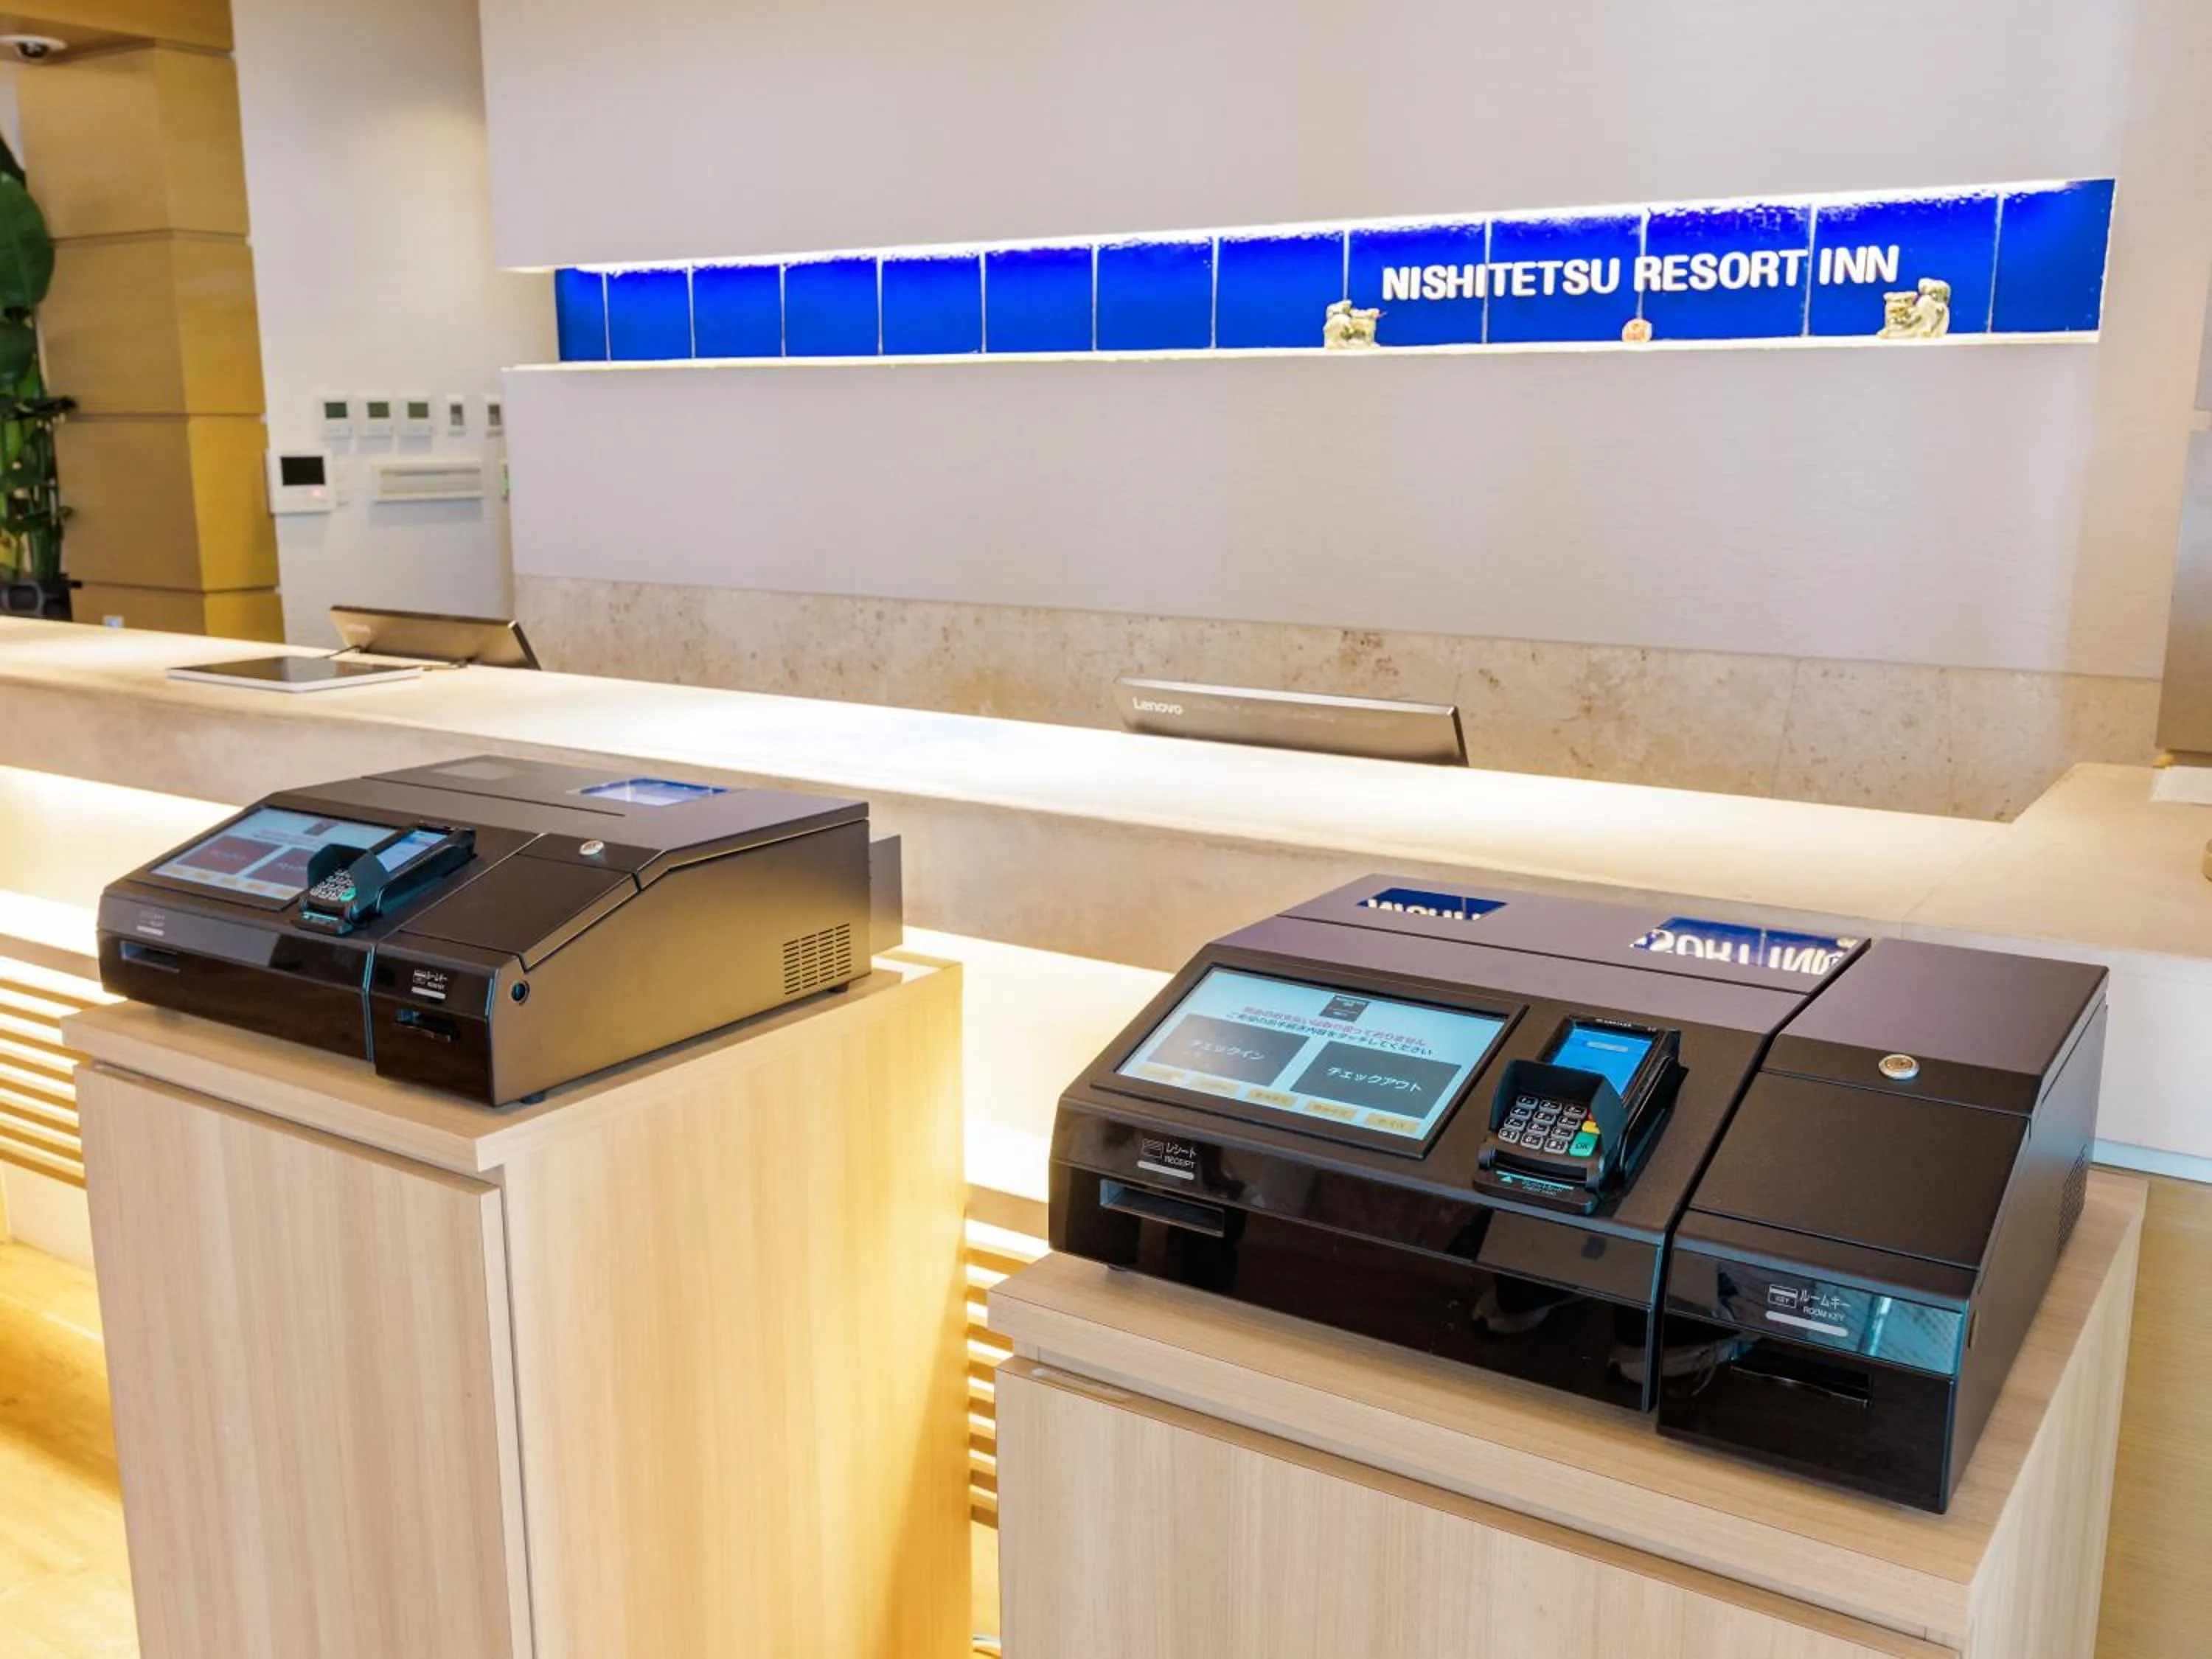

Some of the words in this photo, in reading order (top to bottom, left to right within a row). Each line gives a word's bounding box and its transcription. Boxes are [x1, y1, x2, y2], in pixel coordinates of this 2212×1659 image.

[1382, 259, 1620, 301] NISHITETSU
[1632, 249, 1809, 293] RESORT
[1818, 245, 1900, 285] INN
[1132, 697, 1183, 715] Lenovo
[1189, 1039, 1265, 1061] チェックイン
[1328, 1067, 1422, 1093] チェックアウト
[1166, 1142, 1197, 1159] レシート
[1800, 1289, 1851, 1310] ルームキー
